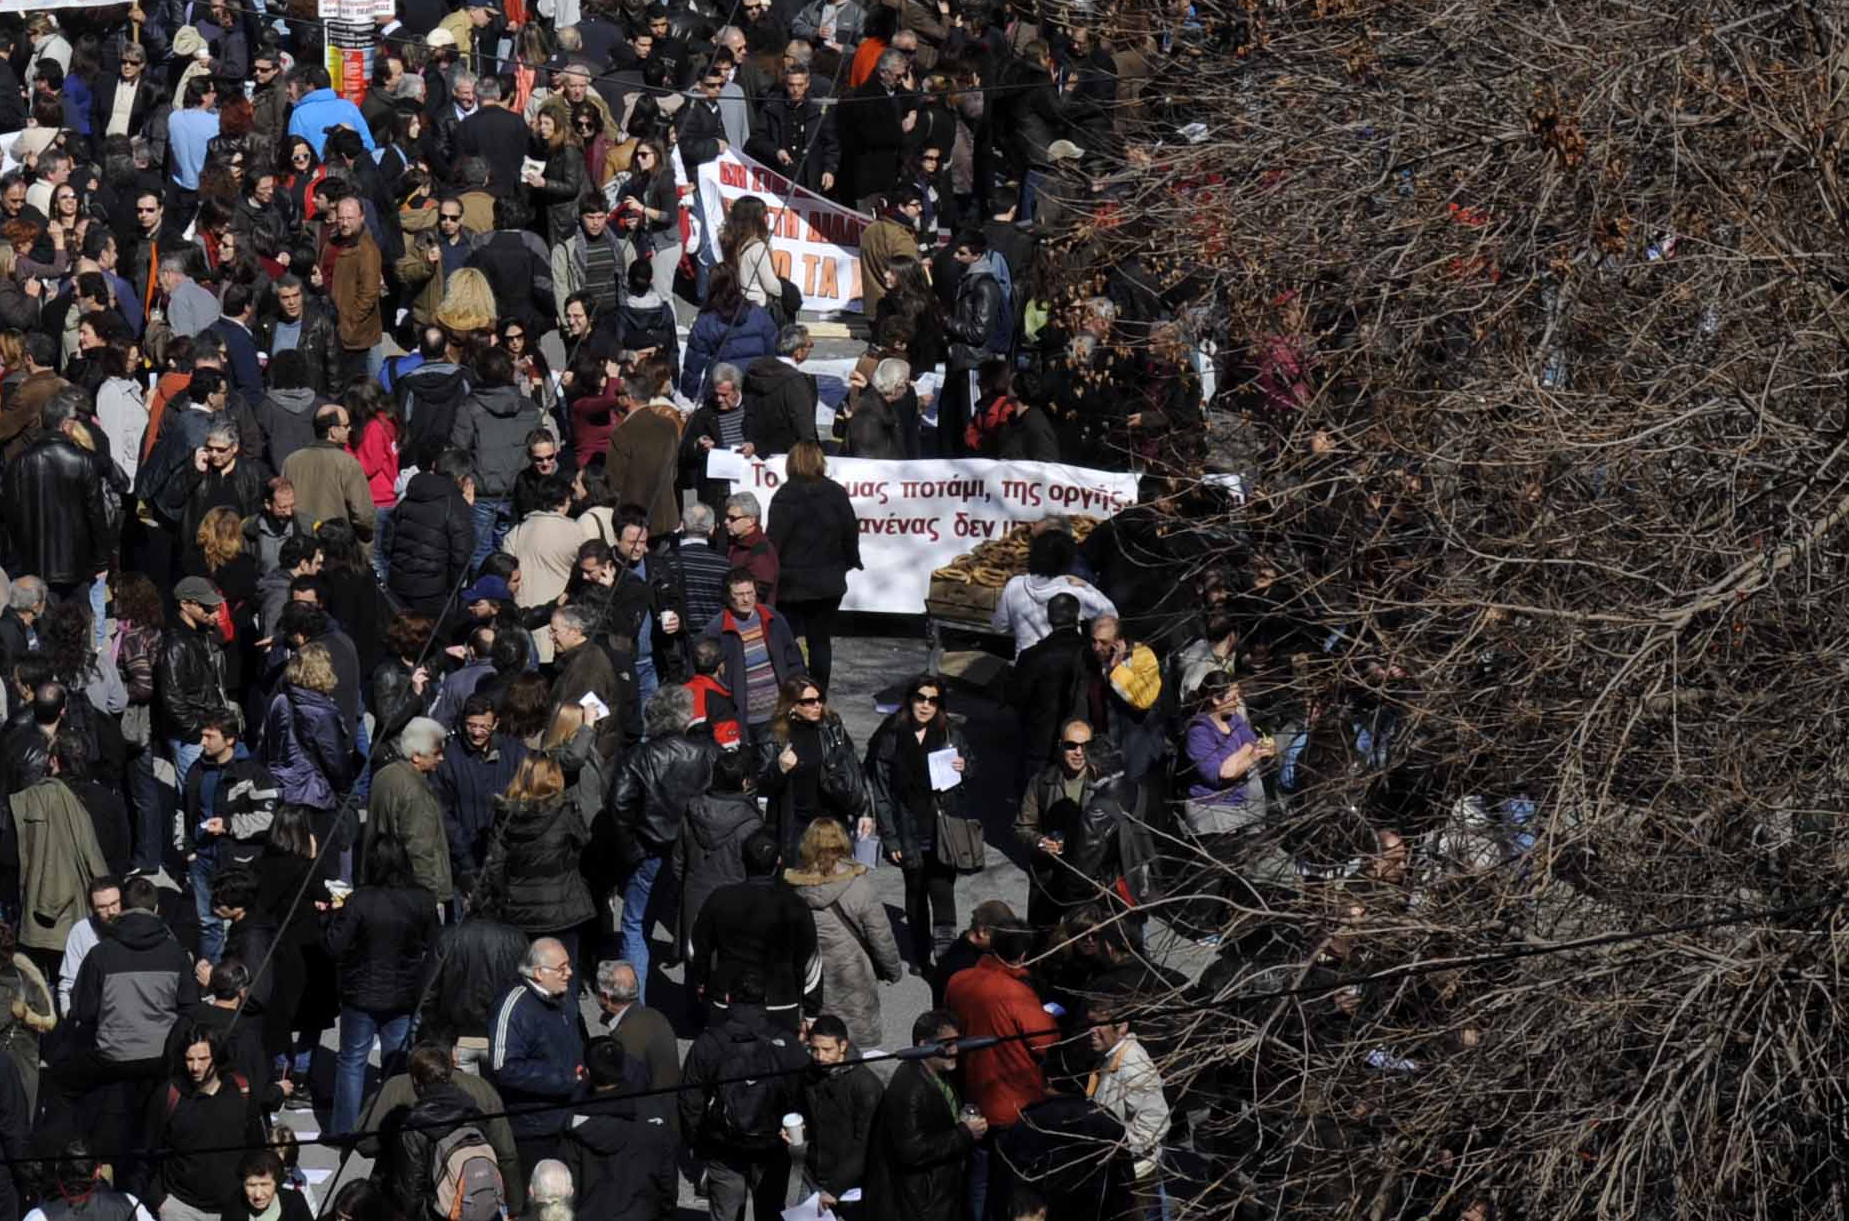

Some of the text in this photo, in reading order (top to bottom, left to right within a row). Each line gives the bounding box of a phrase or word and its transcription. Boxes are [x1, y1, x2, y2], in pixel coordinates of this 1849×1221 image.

[803, 253, 839, 300] ΤΑ
[751, 463, 779, 487] Το
[901, 474, 991, 502] ποτάμι,
[1003, 478, 1041, 504] της
[858, 513, 940, 541] ανένας
[953, 511, 996, 539] δεν
